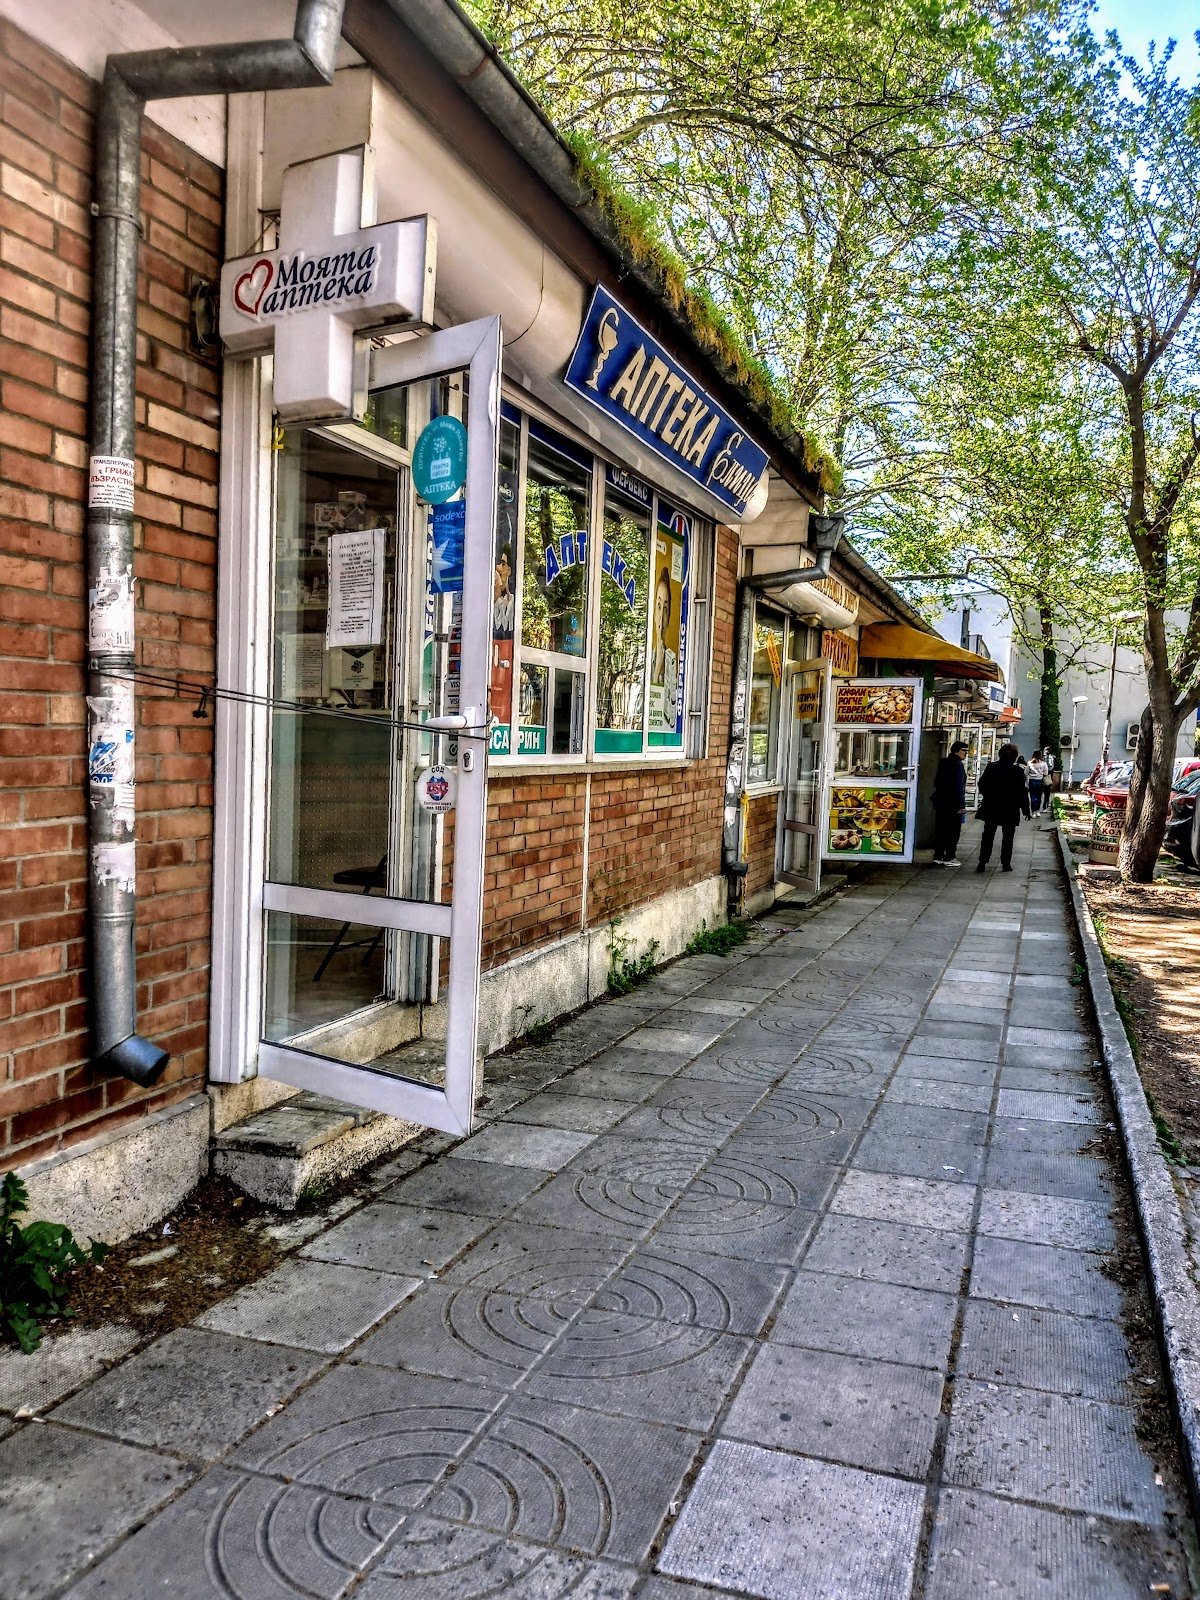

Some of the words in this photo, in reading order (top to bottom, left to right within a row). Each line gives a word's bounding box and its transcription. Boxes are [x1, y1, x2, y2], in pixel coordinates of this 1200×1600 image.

[274, 245, 375, 290] Моята
[262, 269, 373, 315] аптека
[610, 343, 721, 468] АПТЕКА
[423, 480, 457, 495] АПТЕКА
[545, 530, 636, 614] АПТЕКА
[676, 623, 686, 716] ФЕРВЕКС
[837, 696, 863, 705] РОГЧЕ
